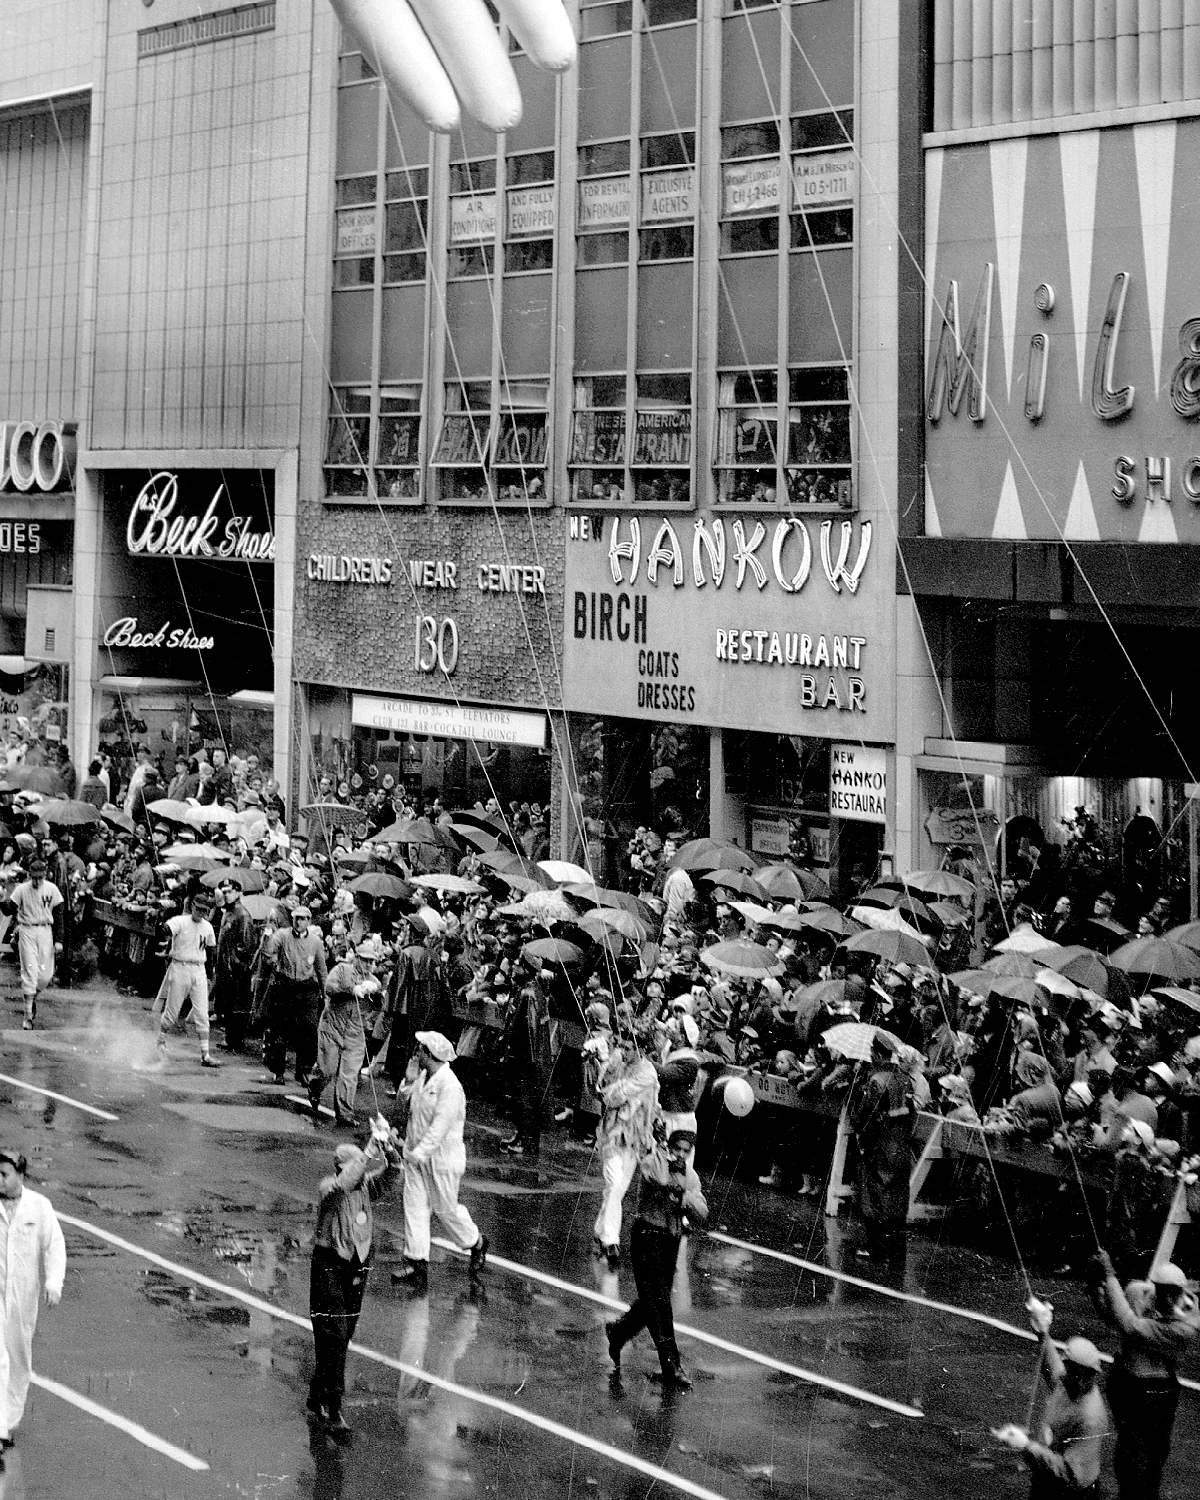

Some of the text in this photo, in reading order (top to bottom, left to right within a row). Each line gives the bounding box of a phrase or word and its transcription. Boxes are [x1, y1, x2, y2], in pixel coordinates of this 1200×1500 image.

[583, 182, 631, 197] FOR RENTAL
[648, 176, 692, 195] EXCLUSIVE
[466, 201, 484, 214] AIR
[511, 192, 553, 207] AND FULLY
[583, 200, 631, 220] INFORMATIO
[652, 195, 689, 214] AGENTS
[453, 216, 497, 236] CONDITIONE
[512, 209, 554, 229] EQUIPPED
[341, 233, 376, 248] OFFICES
[127, 471, 225, 557] Beck
[570, 516, 871, 593] NEW HANKOW
[307, 554, 546, 594] CHILDRENS WEAR CENTER
[574, 591, 648, 644] BIRCH
[104, 617, 214, 649] Beck Shoes
[414, 616, 459, 673] 130
[716, 628, 866, 670] RESTAURANT
[638, 650, 679, 678] COATS
[637, 682, 695, 711] DRESSES
[800, 674, 866, 712] BAR
[382, 702, 413, 714] ARCADE
[418, 705, 428, 715] TO
[445, 708, 455, 718] ST
[463, 709, 511, 725] ELEVATORS
[373, 715, 392, 729] CLUB
[482, 727, 518, 742] LOUNGE
[833, 750, 855, 765] NEW
[831, 791, 886, 815] RESTAURA
